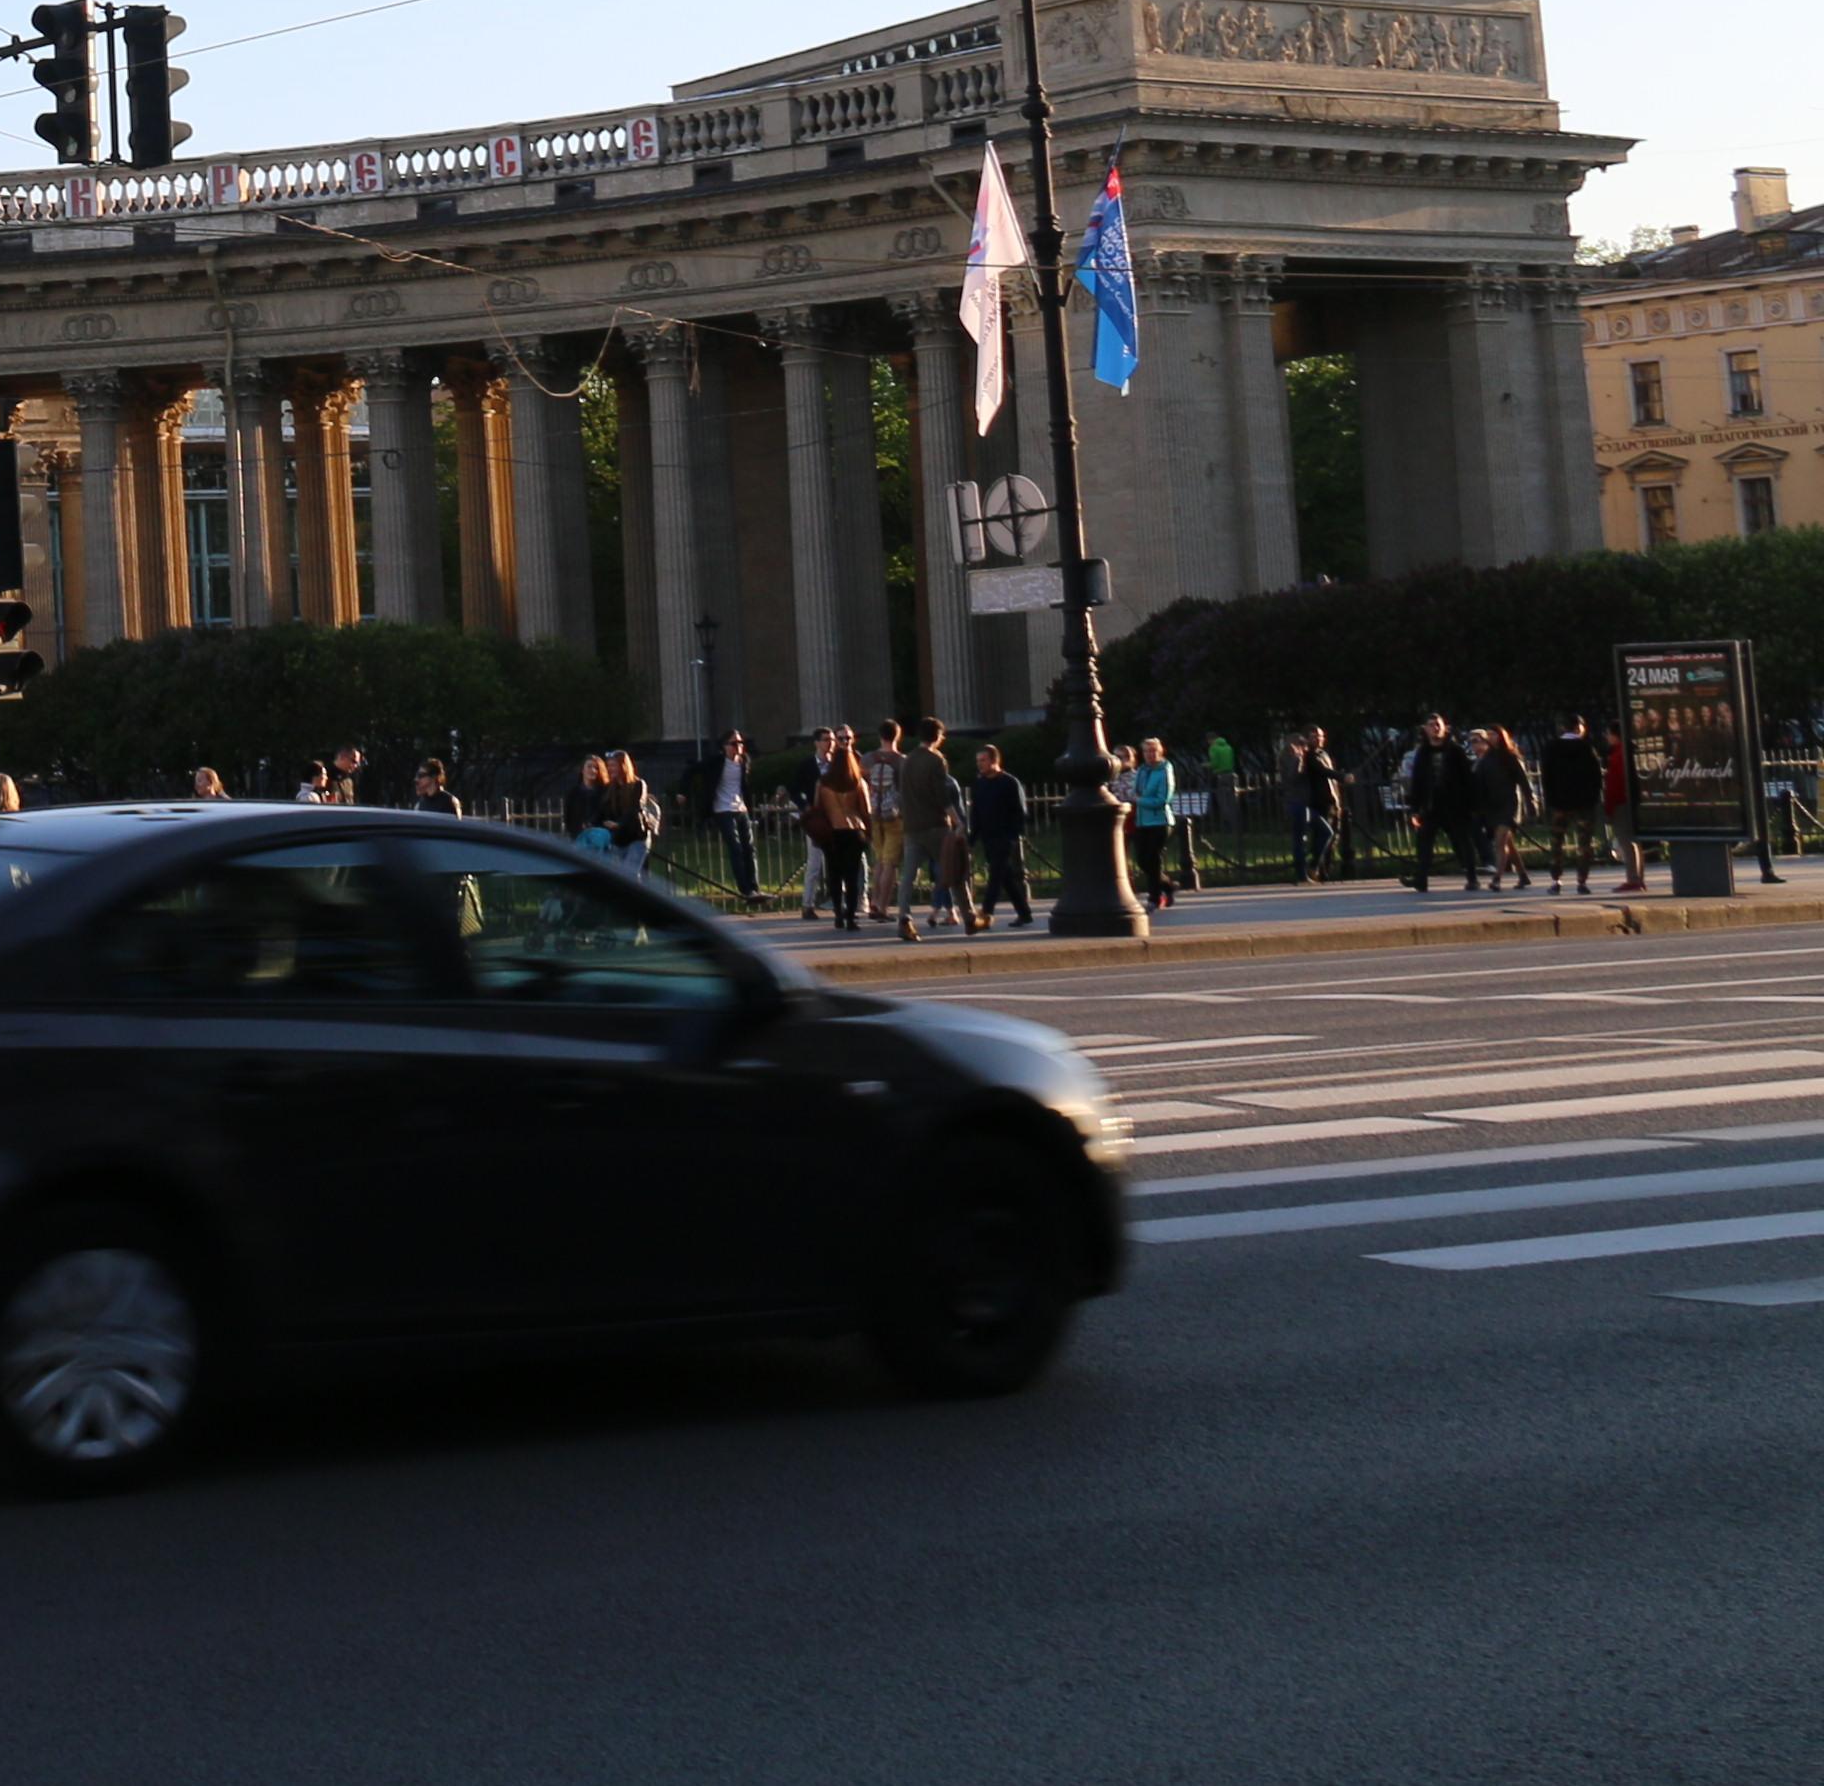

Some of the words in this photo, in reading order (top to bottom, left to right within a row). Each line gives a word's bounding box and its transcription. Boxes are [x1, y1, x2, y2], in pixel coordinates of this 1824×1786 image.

[1627, 667, 1648, 686] 24
[1648, 667, 1680, 685] МАЯ
[1634, 756, 1732, 788] Nightwish
